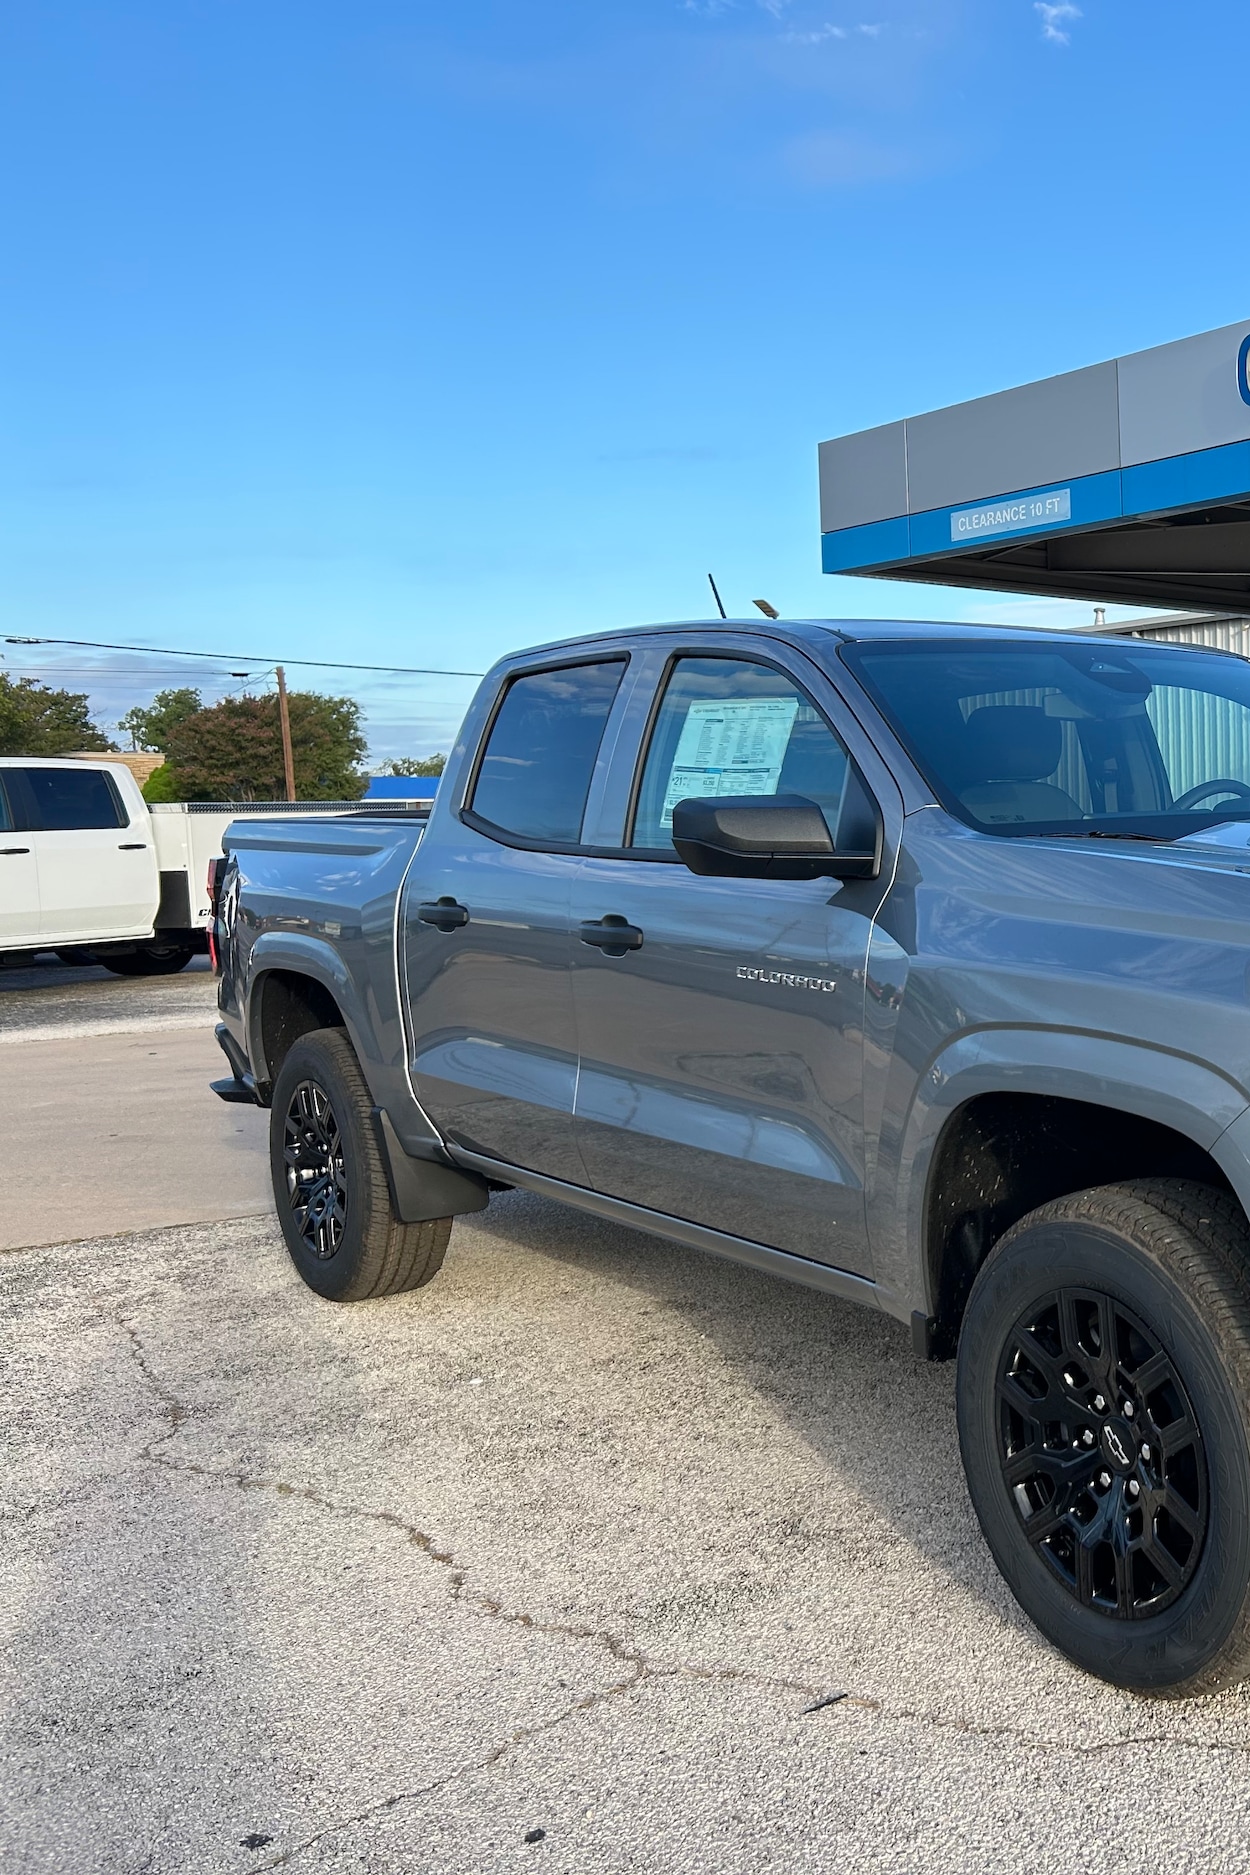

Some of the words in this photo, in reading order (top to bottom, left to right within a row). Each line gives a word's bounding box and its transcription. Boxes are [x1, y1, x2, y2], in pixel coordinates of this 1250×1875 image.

[957, 504, 1027, 532] CLEARANCE
[1030, 502, 1042, 517] 10
[1046, 498, 1060, 514] FT
[735, 966, 837, 993] COLORADO
[1141, 1353, 1232, 1664] GOODYEAR
